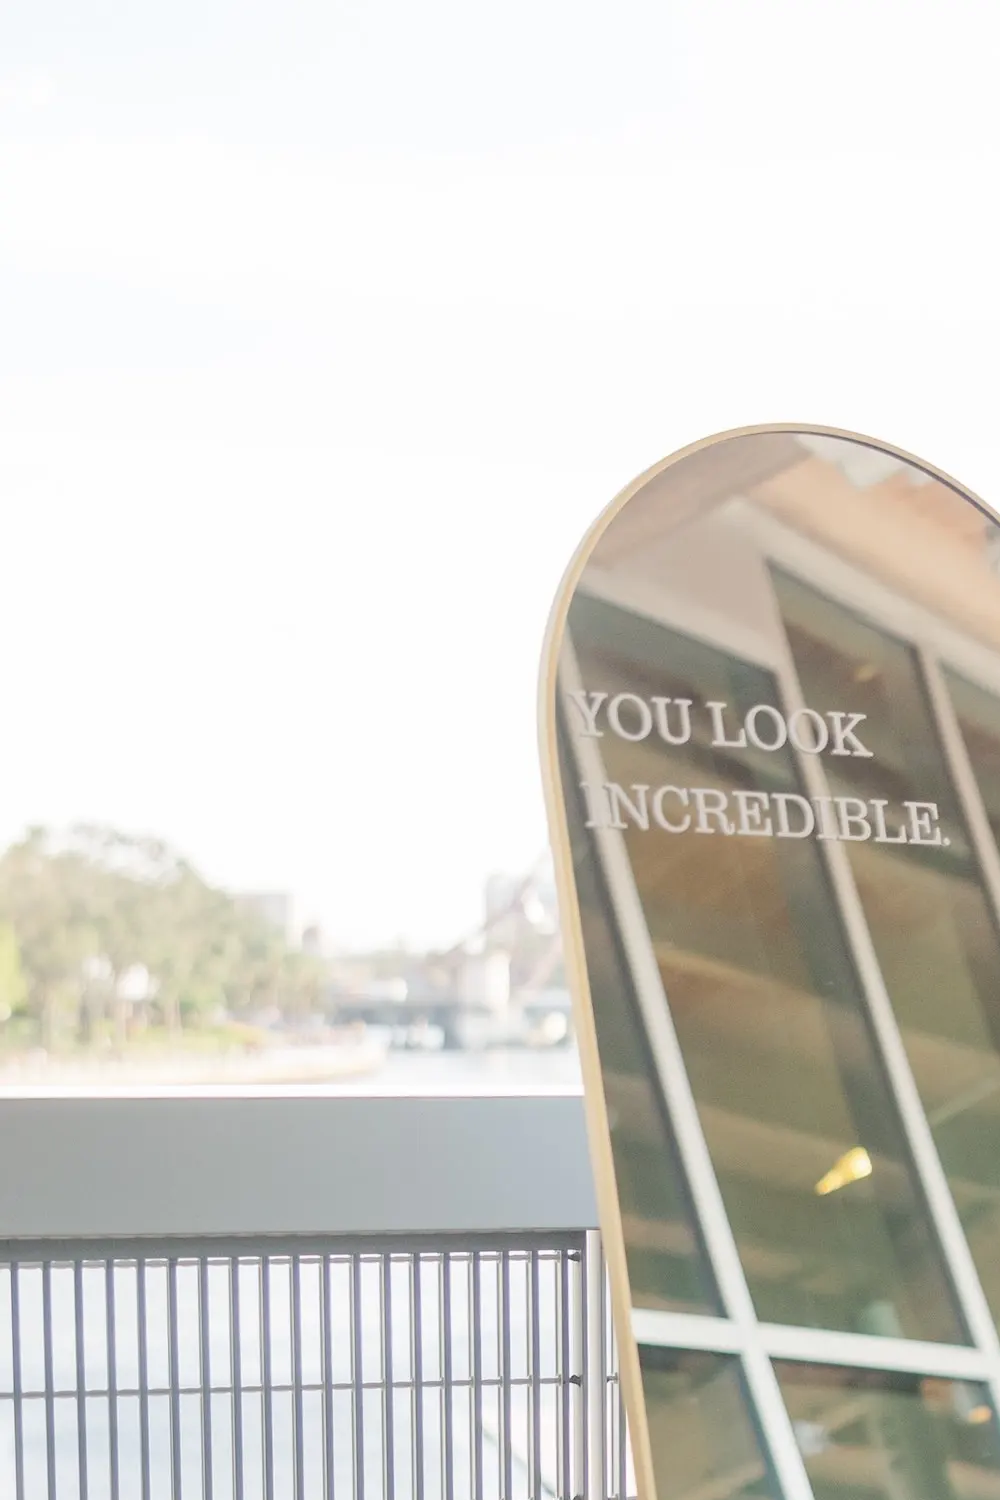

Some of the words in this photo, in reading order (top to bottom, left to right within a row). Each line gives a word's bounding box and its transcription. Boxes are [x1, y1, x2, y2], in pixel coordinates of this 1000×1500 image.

[566, 690, 693, 746] YOU
[705, 700, 874, 758] LOOK
[580, 781, 951, 847] INCREDIBLE.
